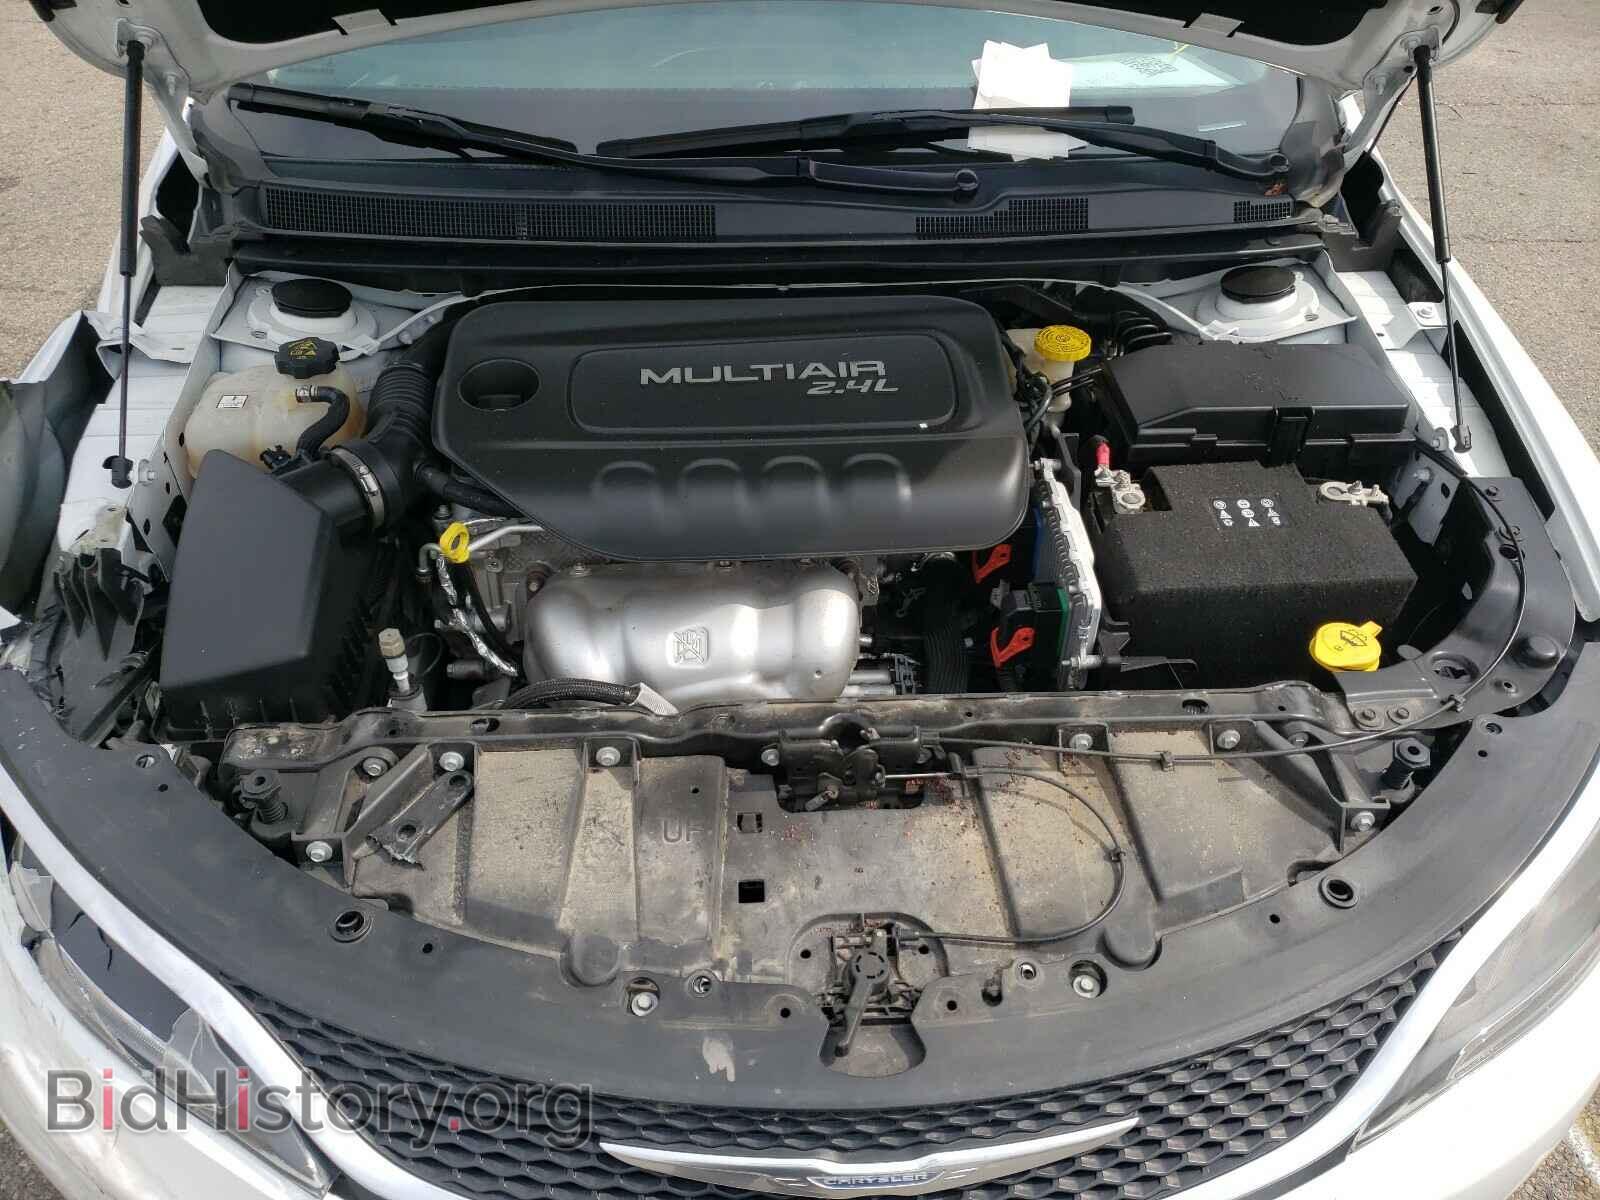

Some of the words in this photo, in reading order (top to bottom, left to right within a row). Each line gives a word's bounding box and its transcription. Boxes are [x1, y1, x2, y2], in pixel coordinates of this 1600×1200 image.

[640, 361, 886, 384] MULTIAIR
[806, 379, 899, 394] 2.4L
[823, 1172, 928, 1185] CHRYSLER
